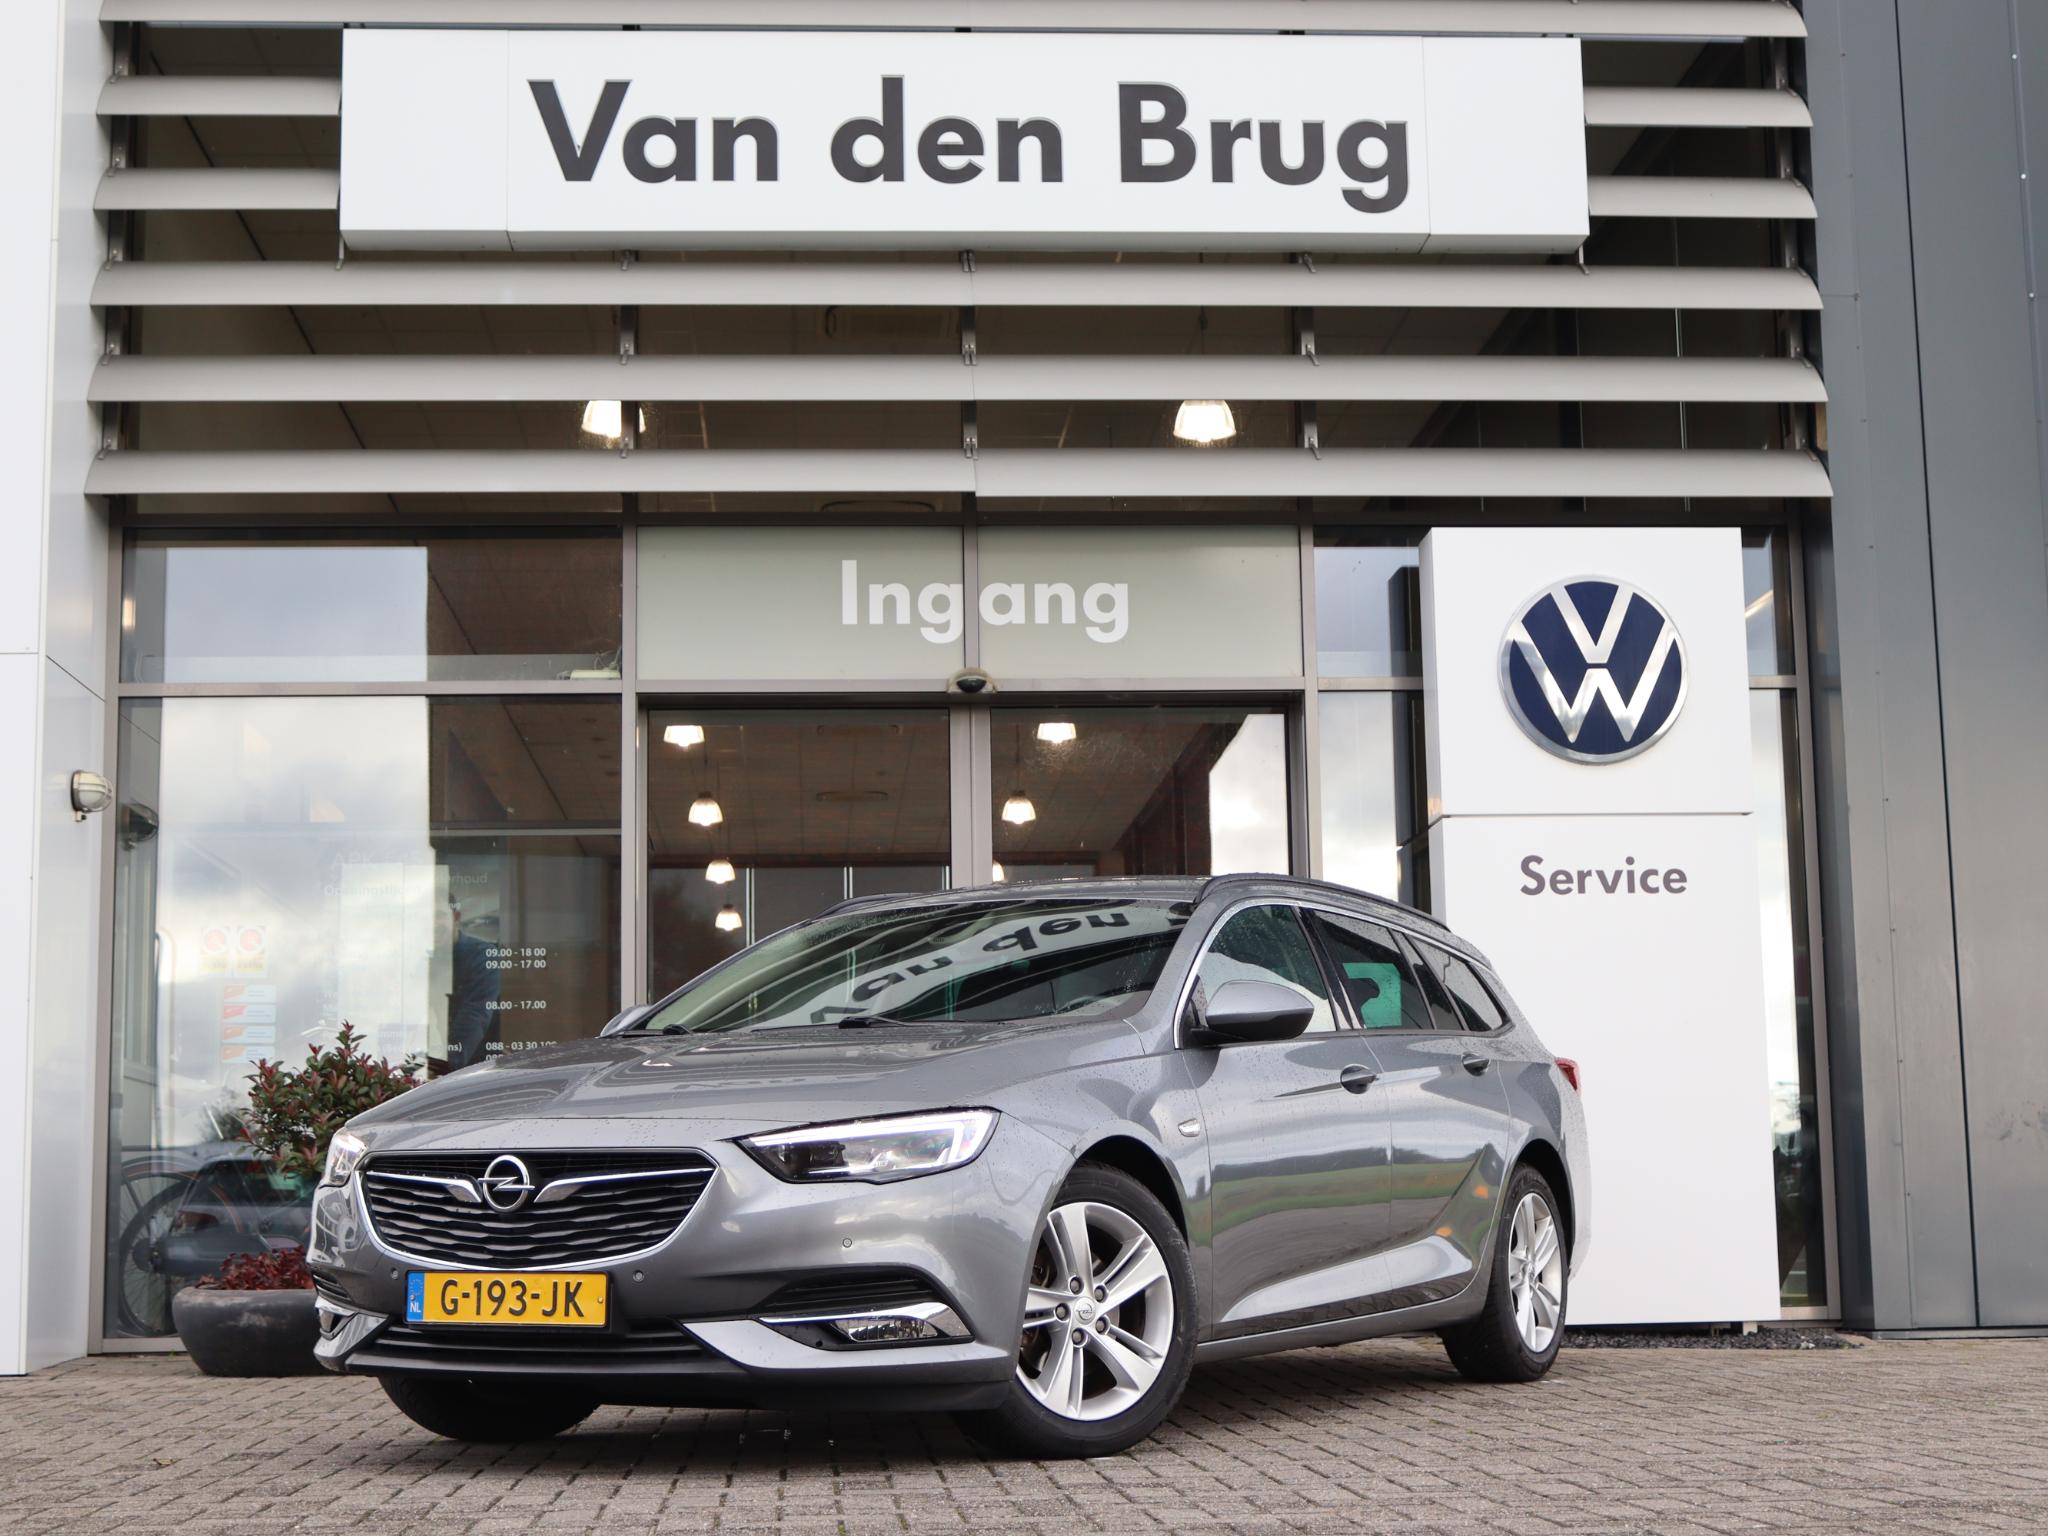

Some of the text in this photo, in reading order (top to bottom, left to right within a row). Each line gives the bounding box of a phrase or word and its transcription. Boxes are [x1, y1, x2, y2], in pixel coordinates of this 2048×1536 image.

[526, 74, 1410, 214] Van den Brug
[841, 559, 1129, 645] Ingang
[1519, 854, 1688, 897] Service
[485, 948, 513, 958] 09.00
[485, 960, 513, 969] 09.00
[485, 1001, 513, 1010] 08.00
[521, 1000, 547, 1009] 17.00
[485, 1042, 504, 1051] 088
[440, 1278, 586, 1318] G-193-JK
[409, 1302, 422, 1314] NL
